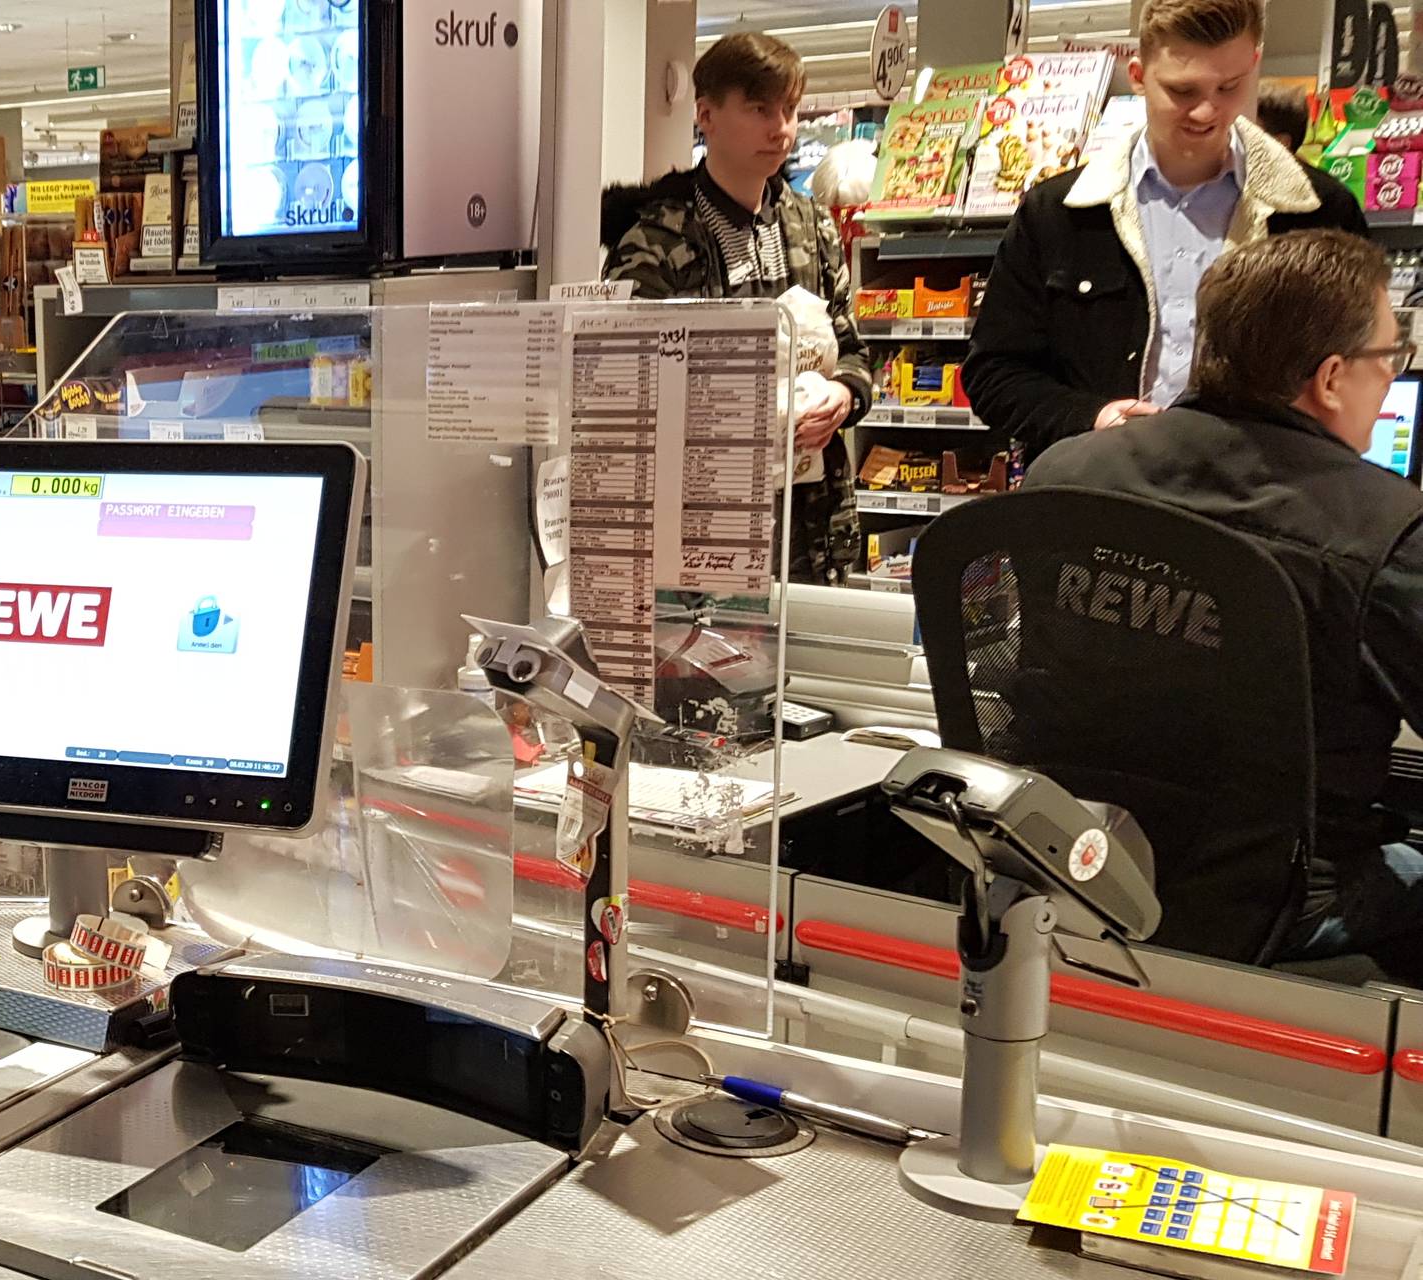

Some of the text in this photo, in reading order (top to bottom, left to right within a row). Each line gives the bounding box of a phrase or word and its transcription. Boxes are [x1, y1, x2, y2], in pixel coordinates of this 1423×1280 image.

[435, 9, 497, 47] skruf
[30, 185, 41, 193] Mit
[63, 183, 90, 192] Prämien
[286, 205, 337, 226] skruf
[469, 203, 485, 218] 18+
[900, 461, 938, 482] RIESEN
[32, 477, 99, 496] 0.000 kg
[105, 504, 225, 519] PASSWORT EINGEBEN
[1055, 562, 1223, 649] REWE
[191, 641, 223, 649] Anmelden
[71, 781, 107, 790] WINCOR
[69, 791, 105, 800] NIXDORF
